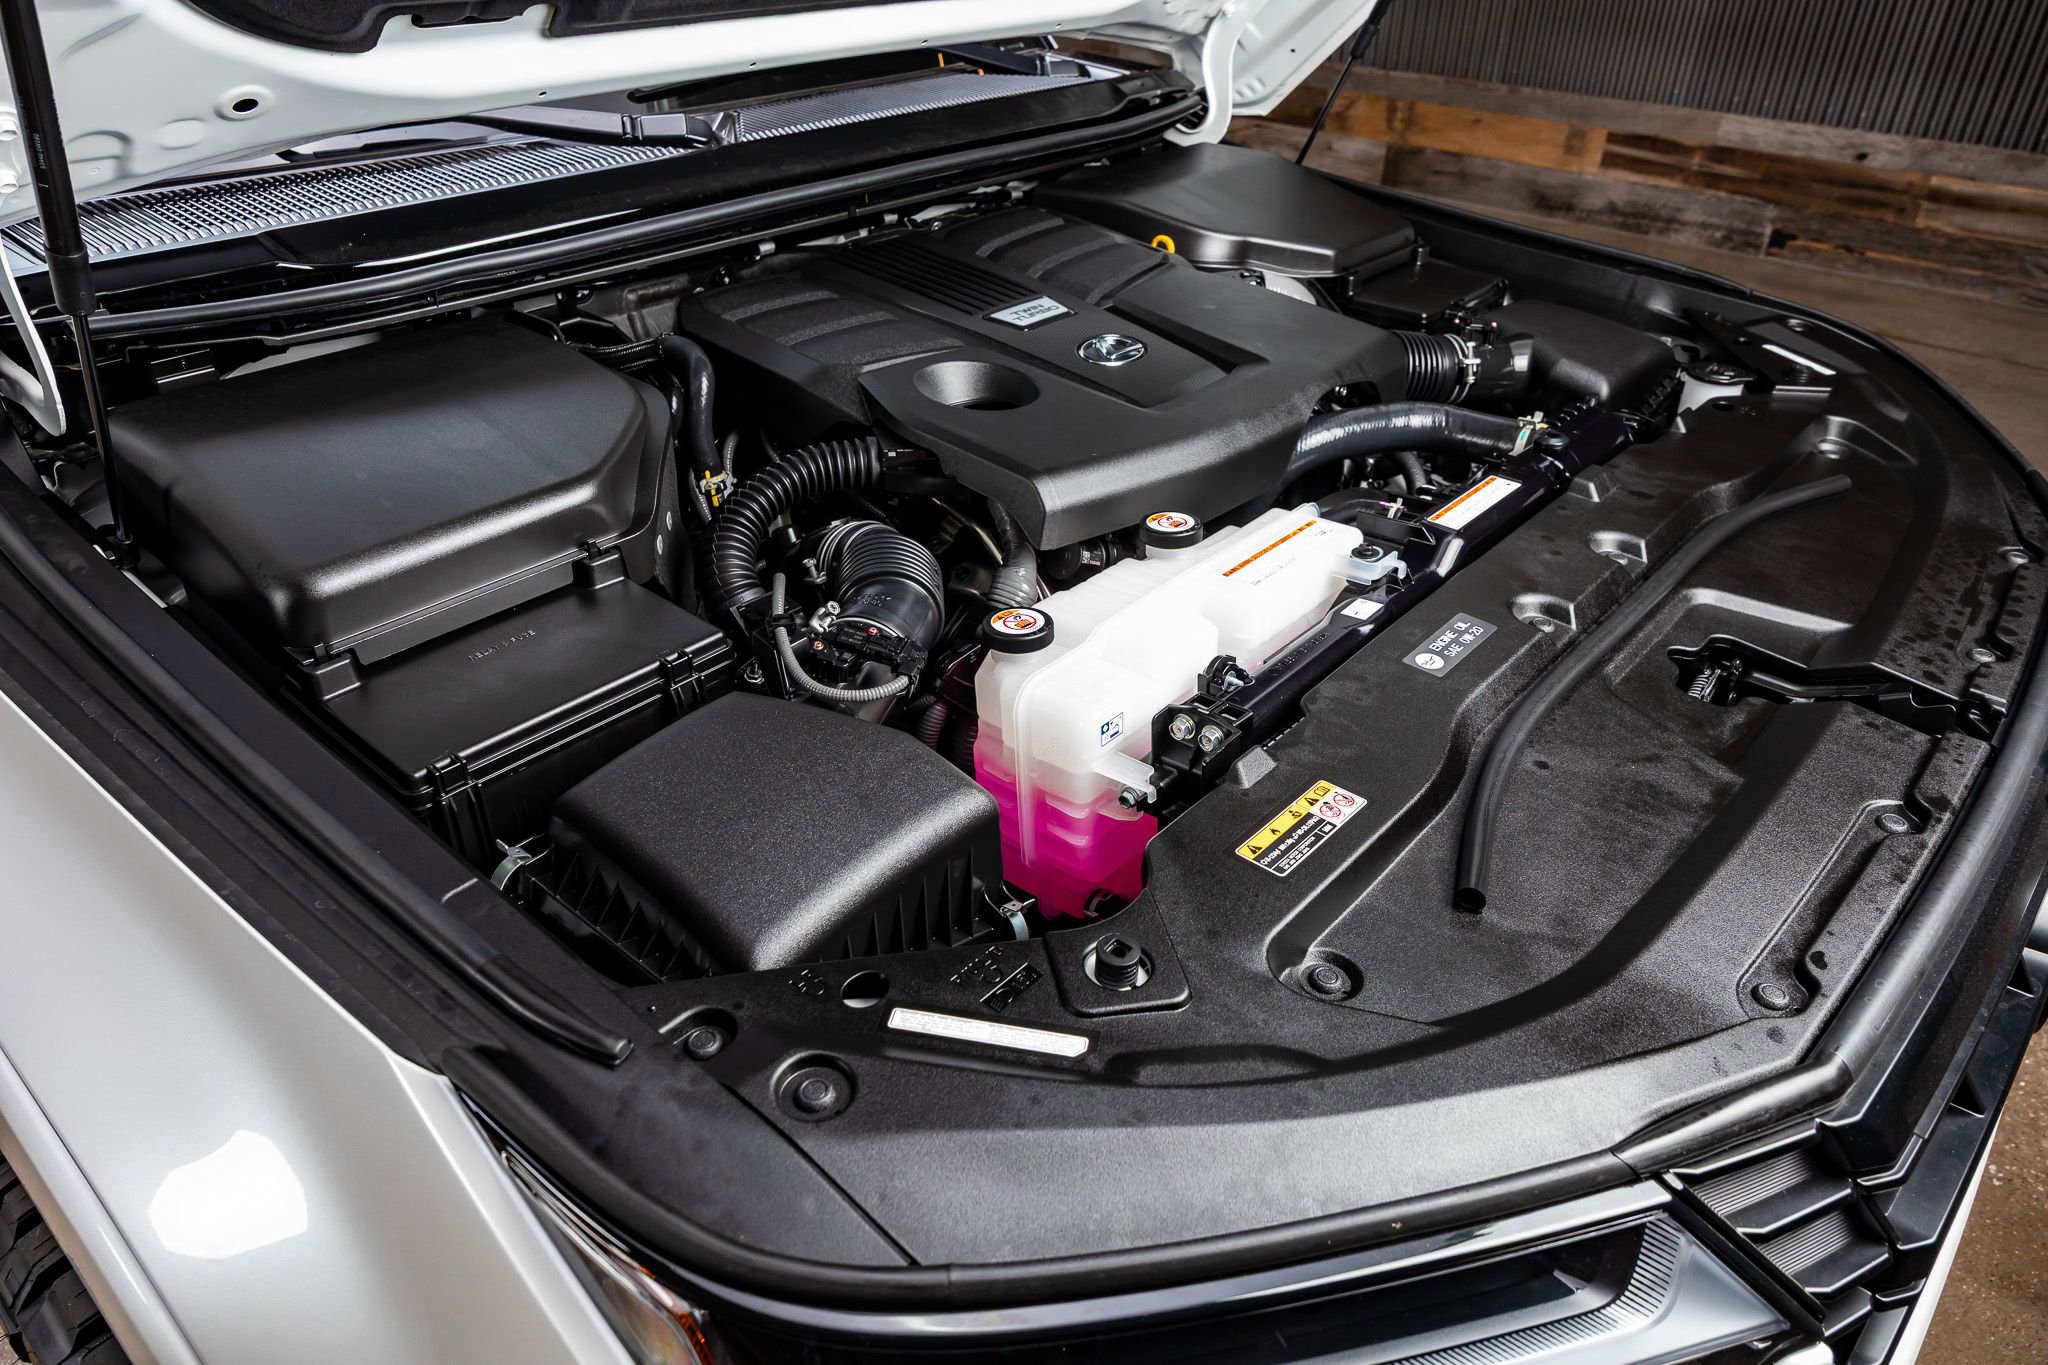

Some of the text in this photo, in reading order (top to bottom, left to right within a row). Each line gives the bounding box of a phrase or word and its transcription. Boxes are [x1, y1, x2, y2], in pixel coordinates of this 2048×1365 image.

[1009, 303, 1045, 316] TWIN
[1011, 305, 1060, 322] TURBO
[468, 644, 500, 661] RELAY
[510, 629, 536, 643] FUSE
[1428, 621, 1471, 652] ENGINE OIL
[1443, 625, 1484, 657] SAE 0W-20
